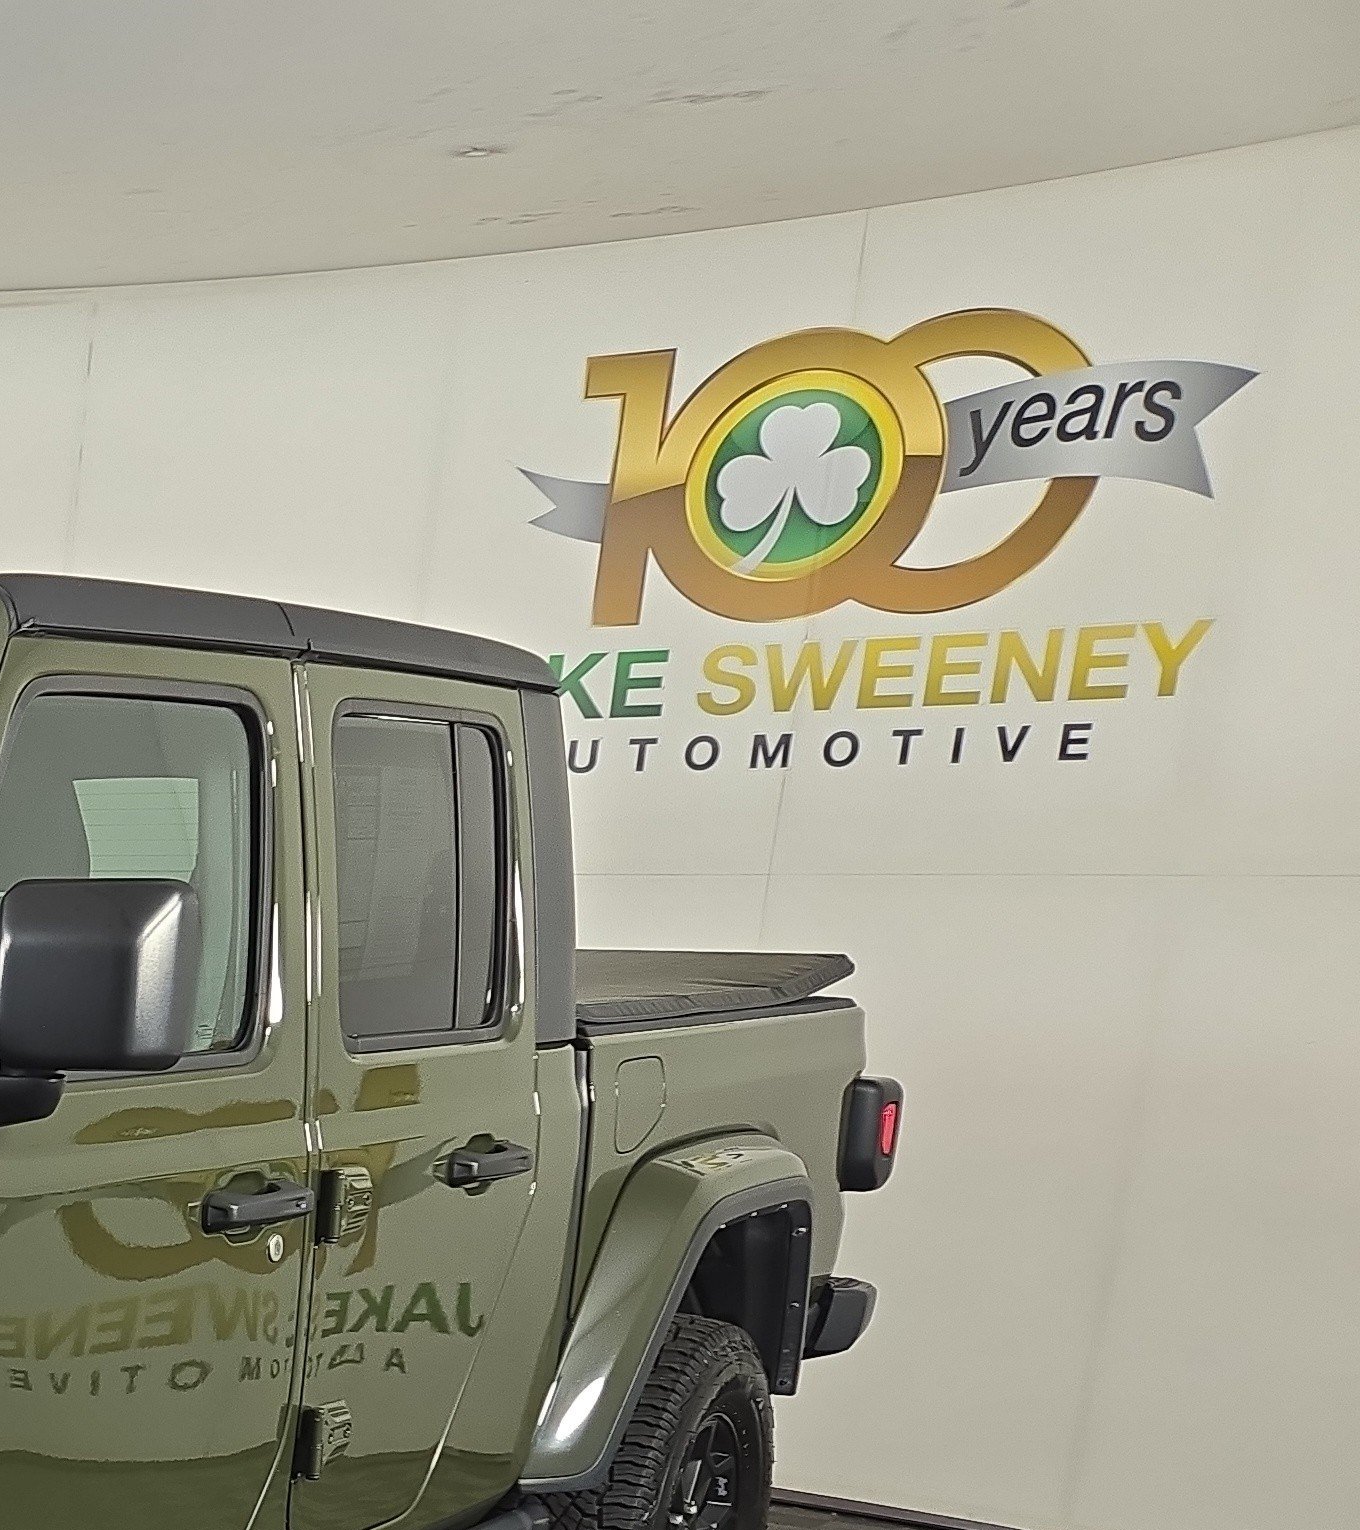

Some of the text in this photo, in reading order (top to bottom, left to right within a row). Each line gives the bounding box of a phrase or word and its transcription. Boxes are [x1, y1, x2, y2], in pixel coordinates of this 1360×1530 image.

[584, 306, 1101, 627] 100
[958, 377, 1182, 478] years
[548, 617, 1215, 719] KE SWEENEY
[567, 722, 1093, 774] UTOMOTIVE
